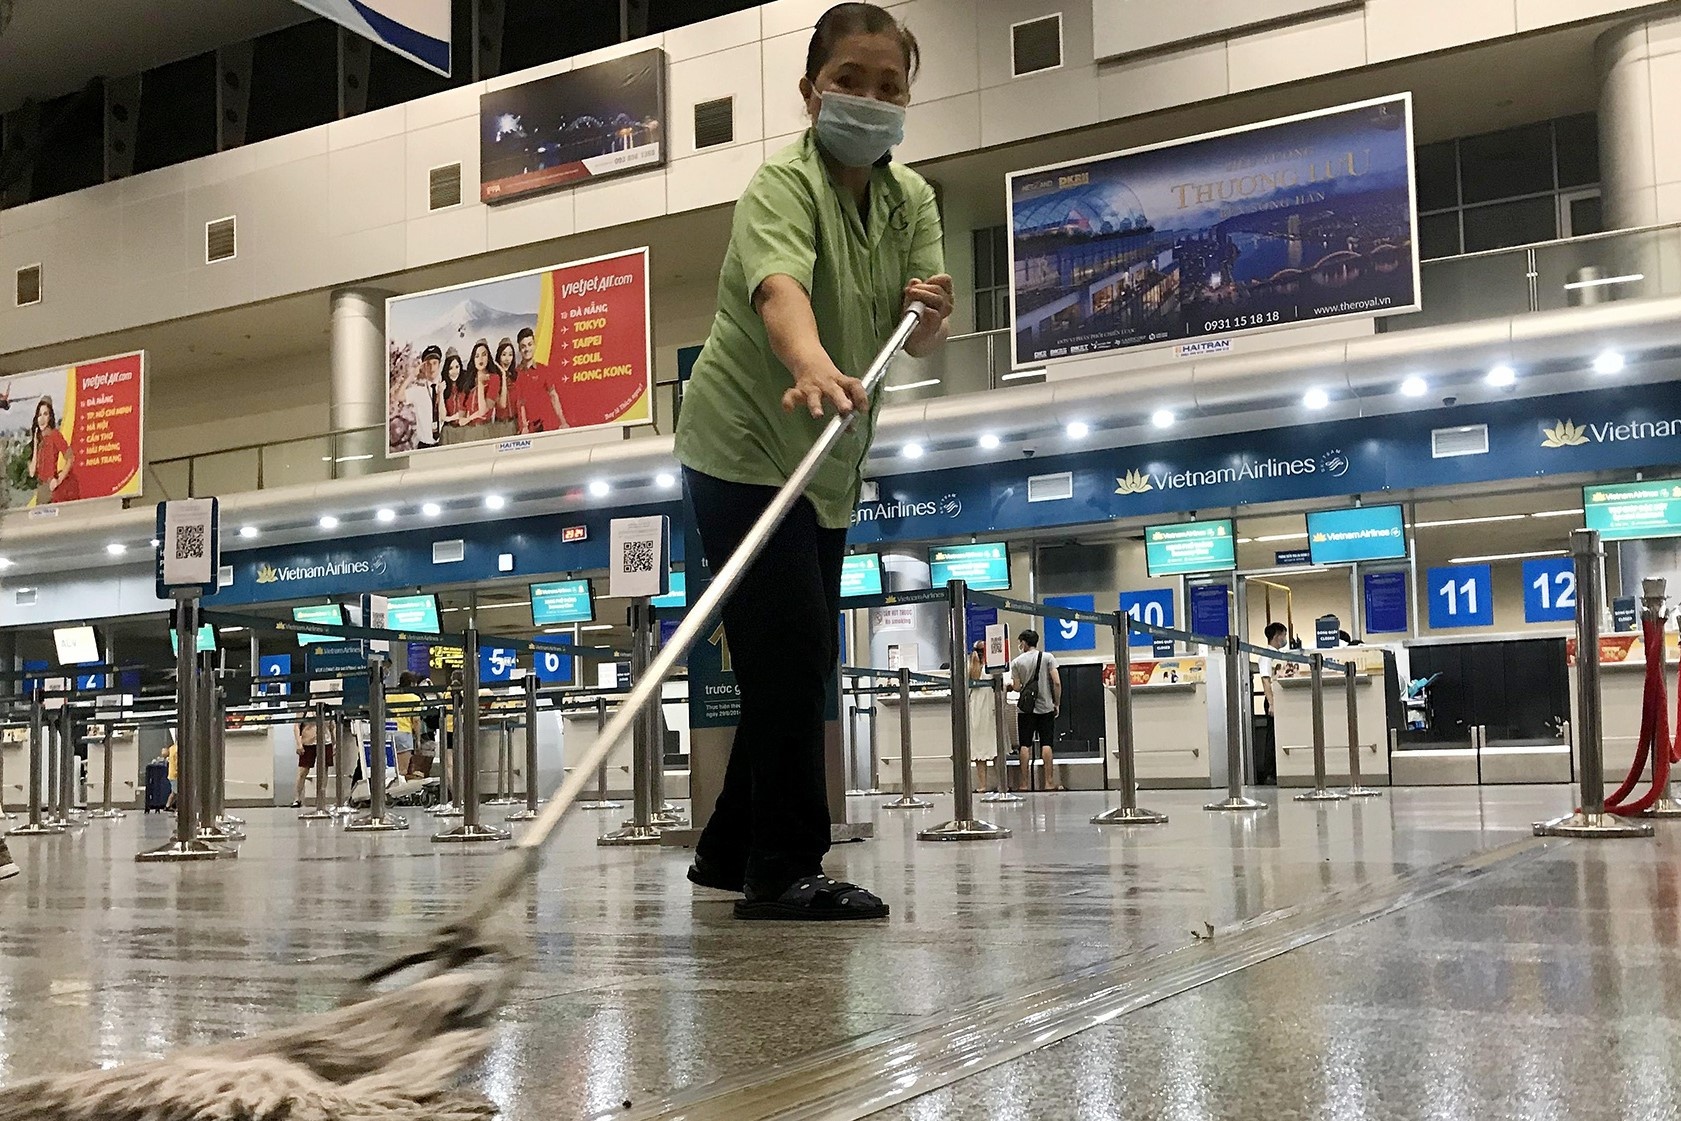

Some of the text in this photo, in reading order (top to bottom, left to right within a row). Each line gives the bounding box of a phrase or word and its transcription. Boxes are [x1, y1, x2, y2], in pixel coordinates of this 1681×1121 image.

[570, 305, 583, 318] ĐÀ
[1313, 296, 1392, 315] www.theroyal.vn
[574, 318, 606, 333] TOKYO
[1203, 312, 1280, 332] 0931 15 18 18
[572, 335, 602, 349] TAIPEI
[572, 352, 603, 366] SEOUL
[573, 364, 632, 383] HONG KONG
[1439, 578, 1477, 615] 11
[1532, 571, 1576, 609] 12
